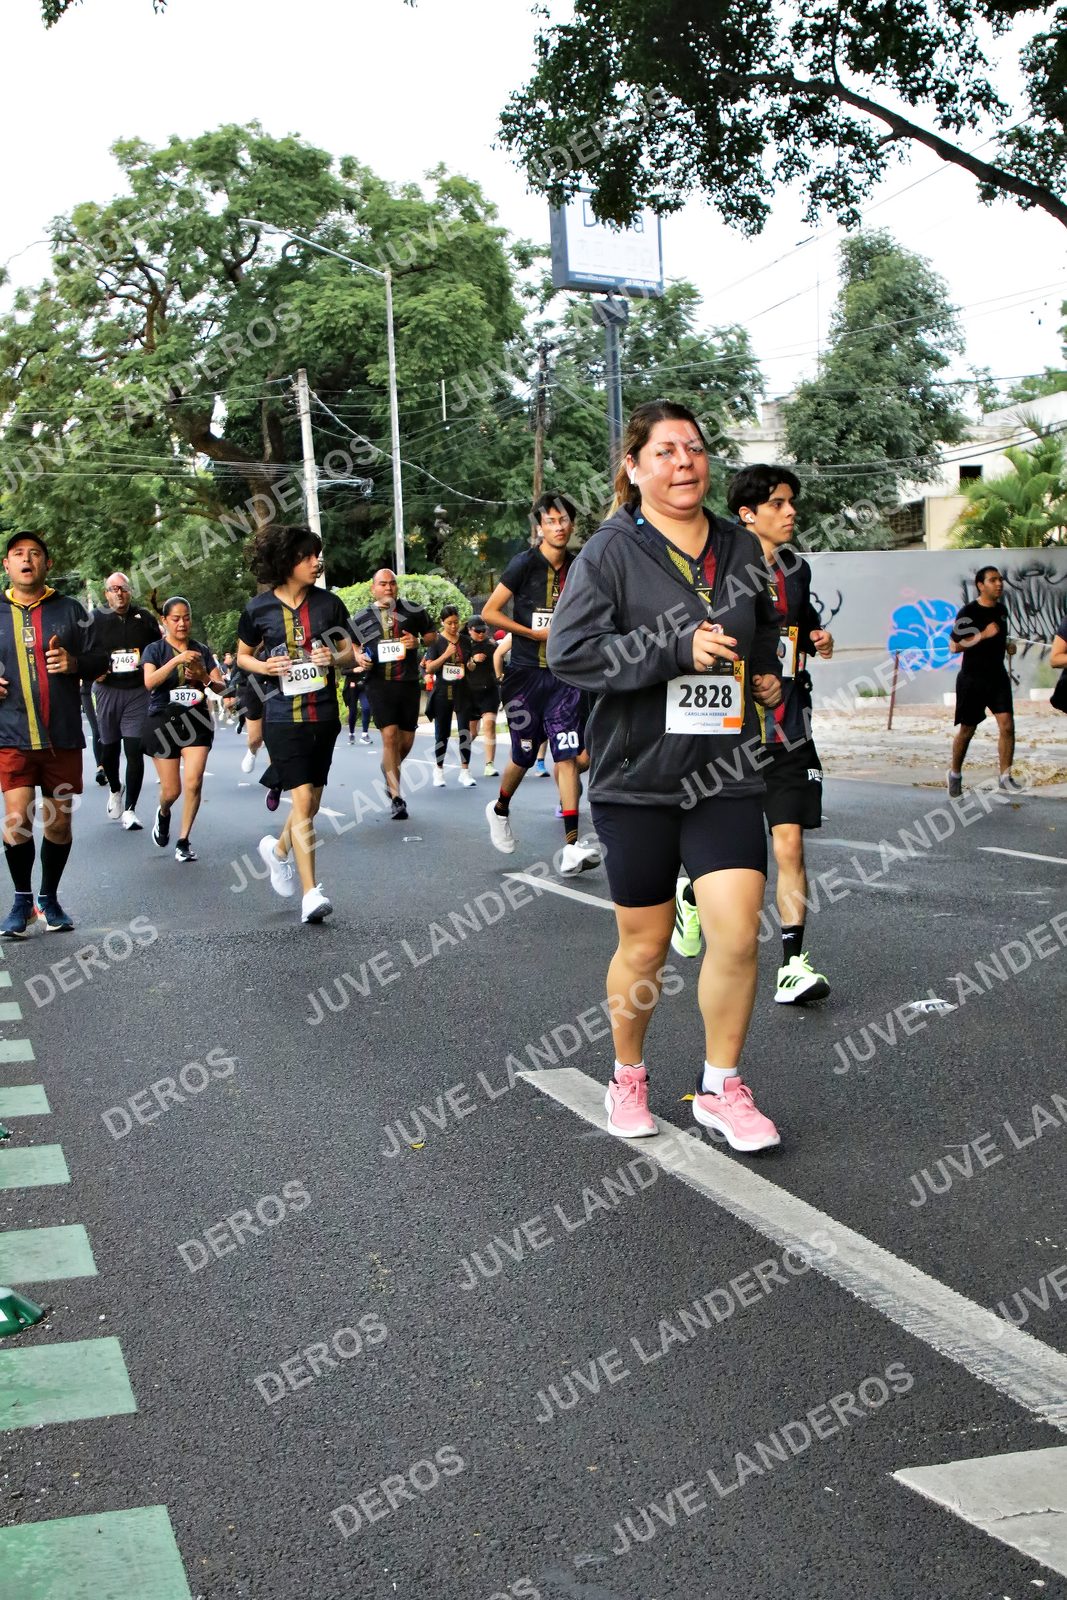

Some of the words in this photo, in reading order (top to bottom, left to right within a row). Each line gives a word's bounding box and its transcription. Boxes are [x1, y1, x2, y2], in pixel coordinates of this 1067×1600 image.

[537, 616, 553, 628] 37
[382, 645, 401, 653] 2106
[287, 667, 317, 683] 3880
[175, 692, 197, 700] 3879
[679, 684, 733, 708] 2828
[557, 731, 579, 750] 20
